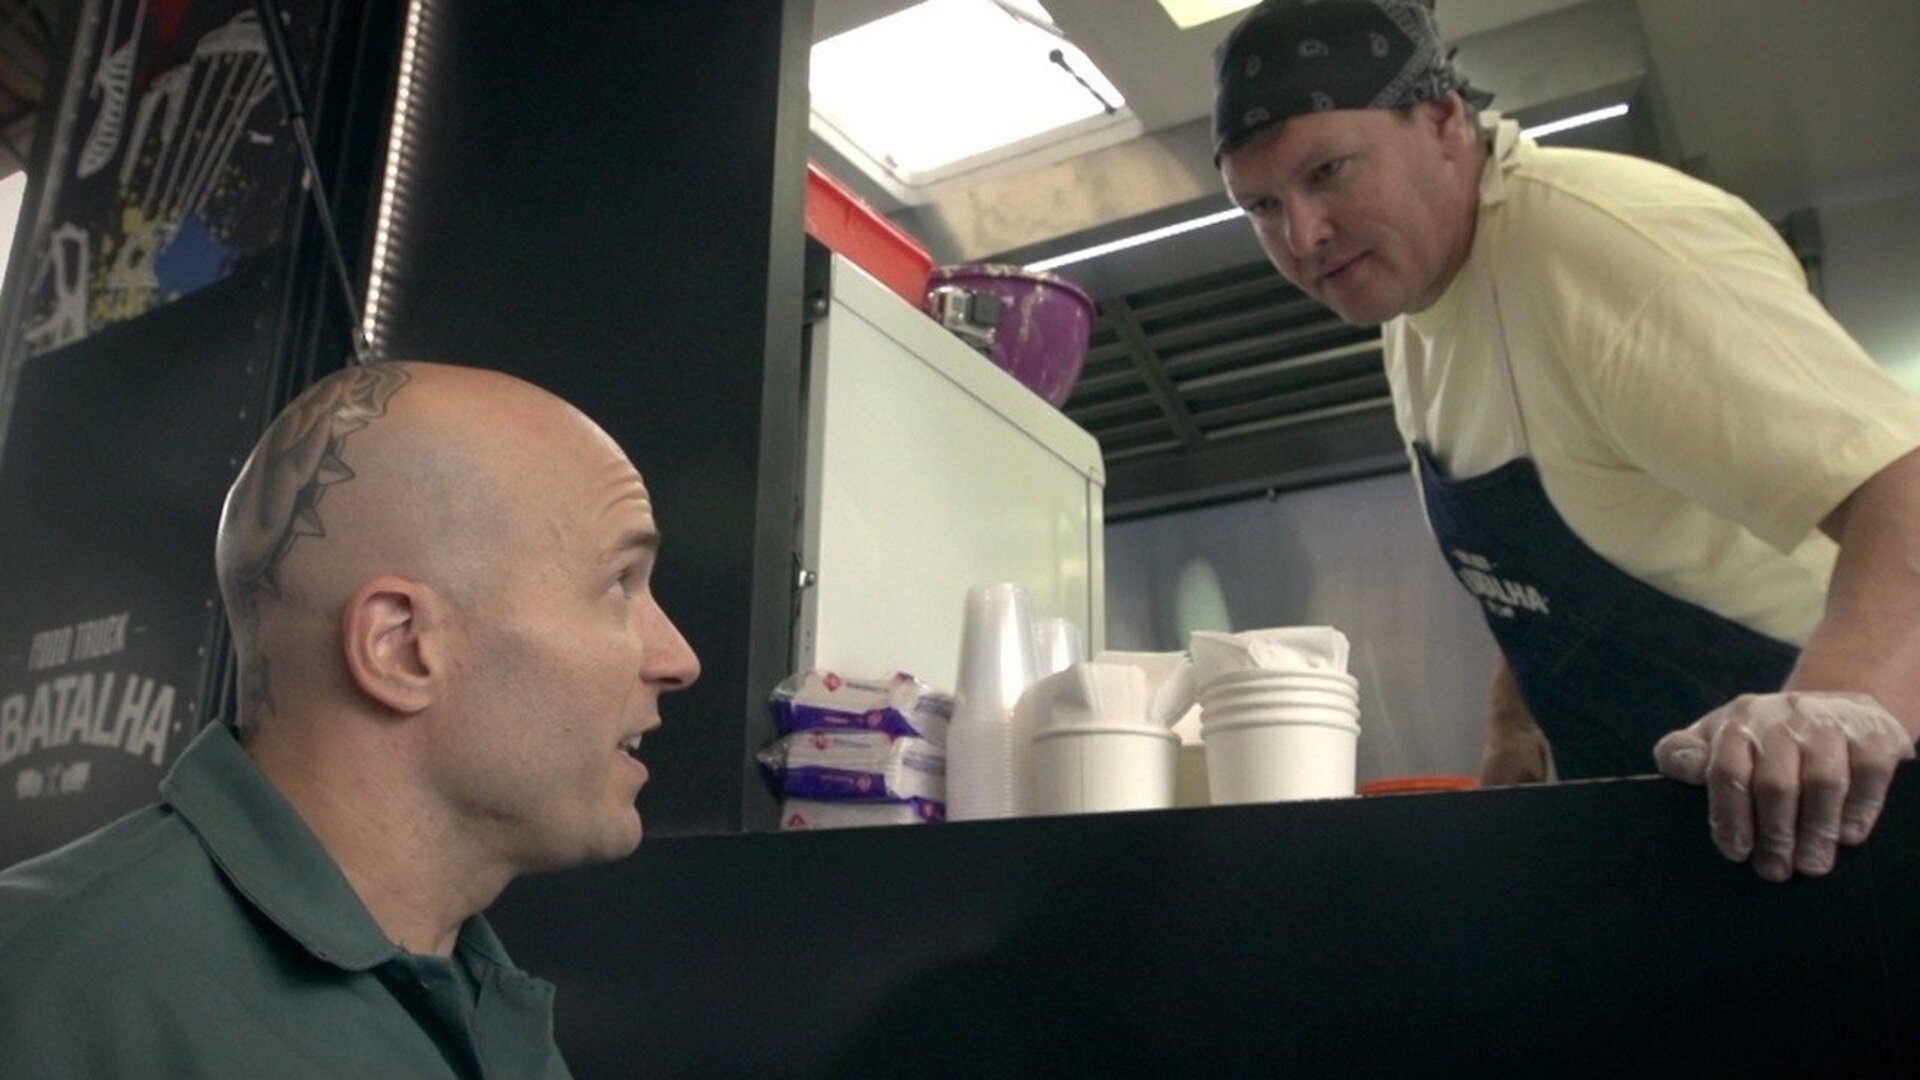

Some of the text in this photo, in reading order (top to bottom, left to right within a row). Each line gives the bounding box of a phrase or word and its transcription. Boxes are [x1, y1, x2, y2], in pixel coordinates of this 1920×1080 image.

[28, 612, 130, 671] FOOD TRUCK
[0, 671, 176, 767] BATALHA
